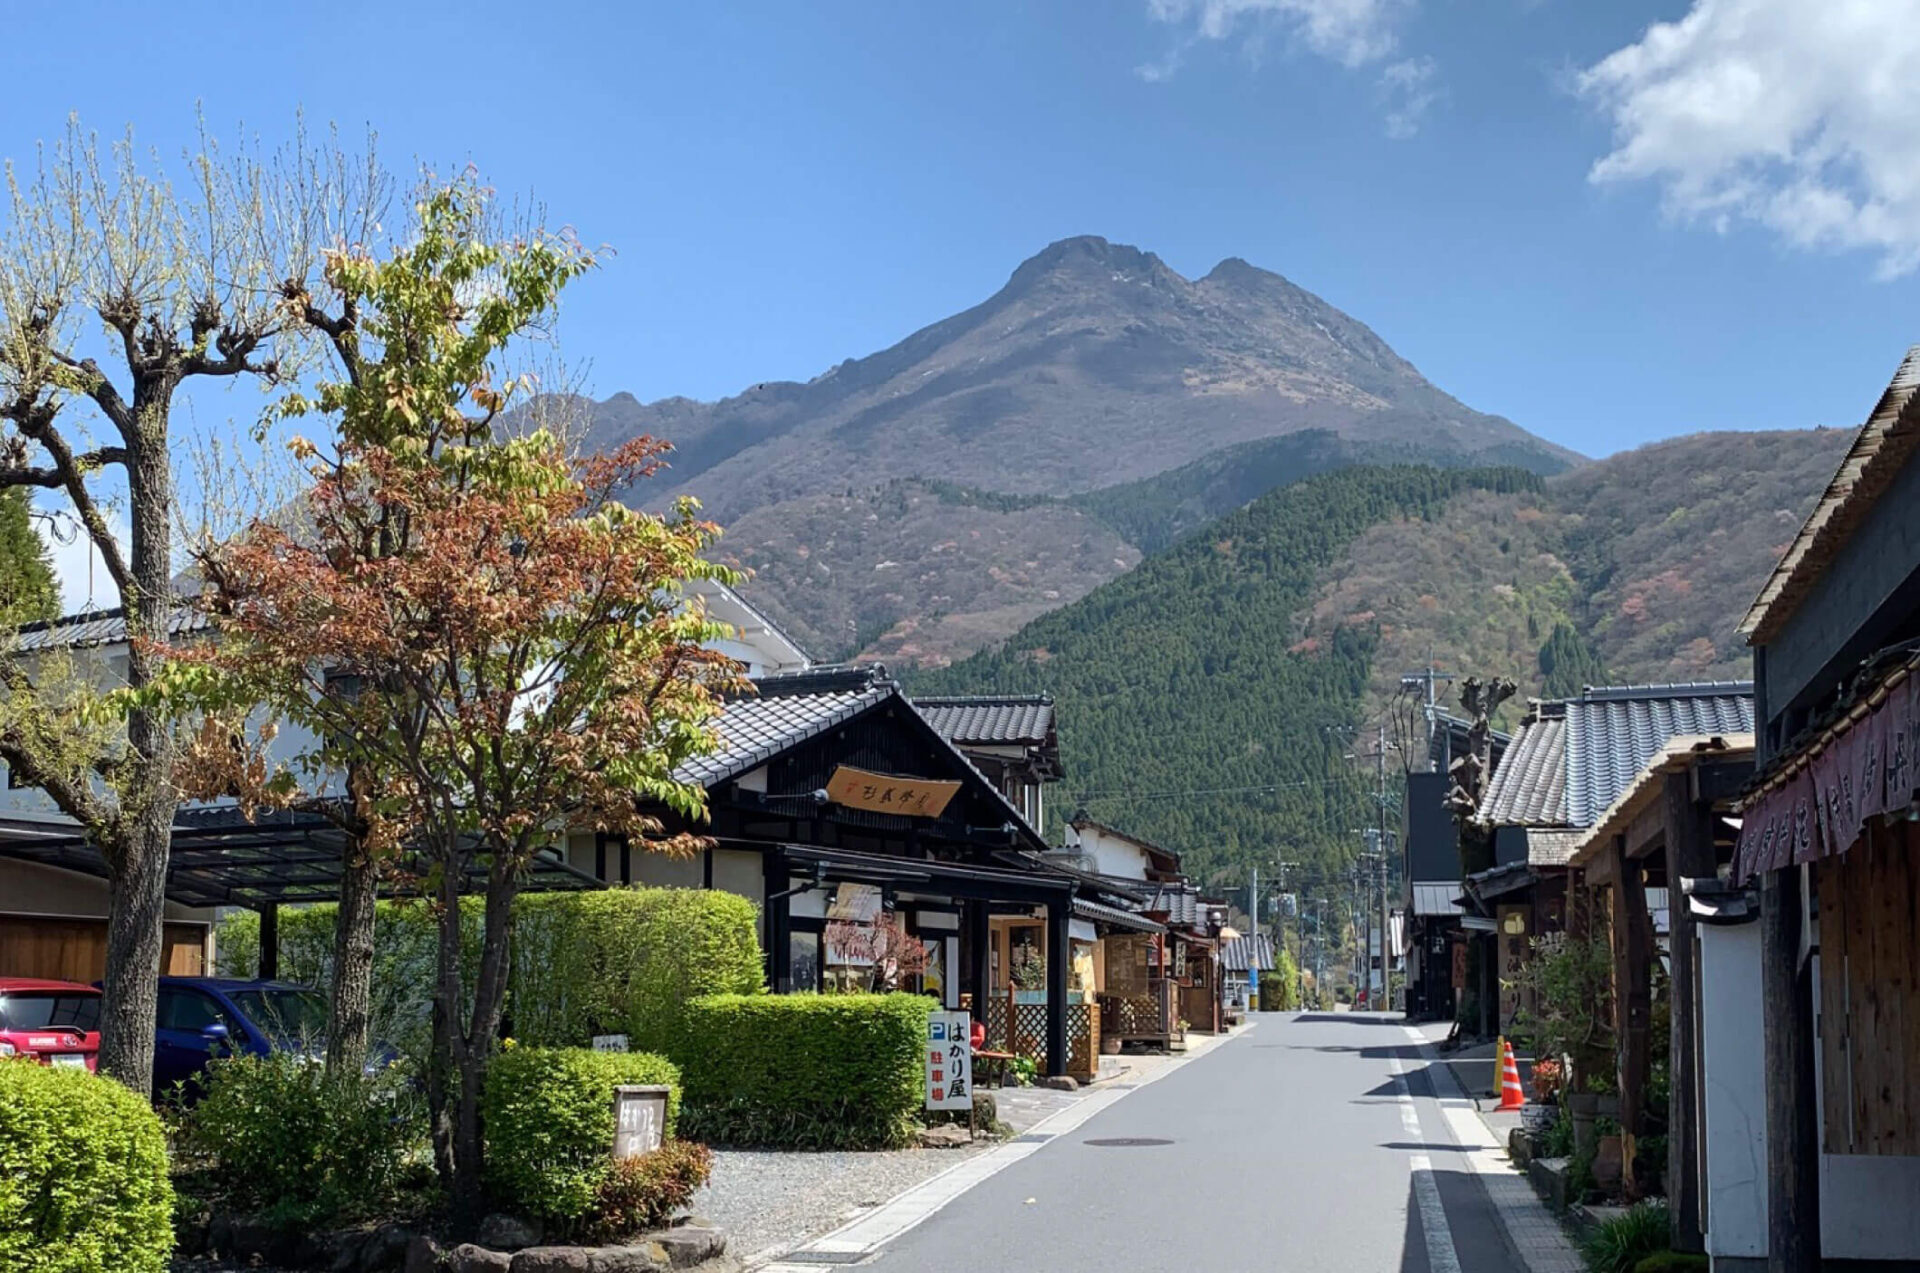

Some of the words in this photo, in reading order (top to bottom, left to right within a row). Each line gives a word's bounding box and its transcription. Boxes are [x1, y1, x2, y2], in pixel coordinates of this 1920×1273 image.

[930, 1023, 944, 1039] P
[930, 1051, 944, 1102] 駐車場
[947, 1022, 967, 1098] はかり屋
